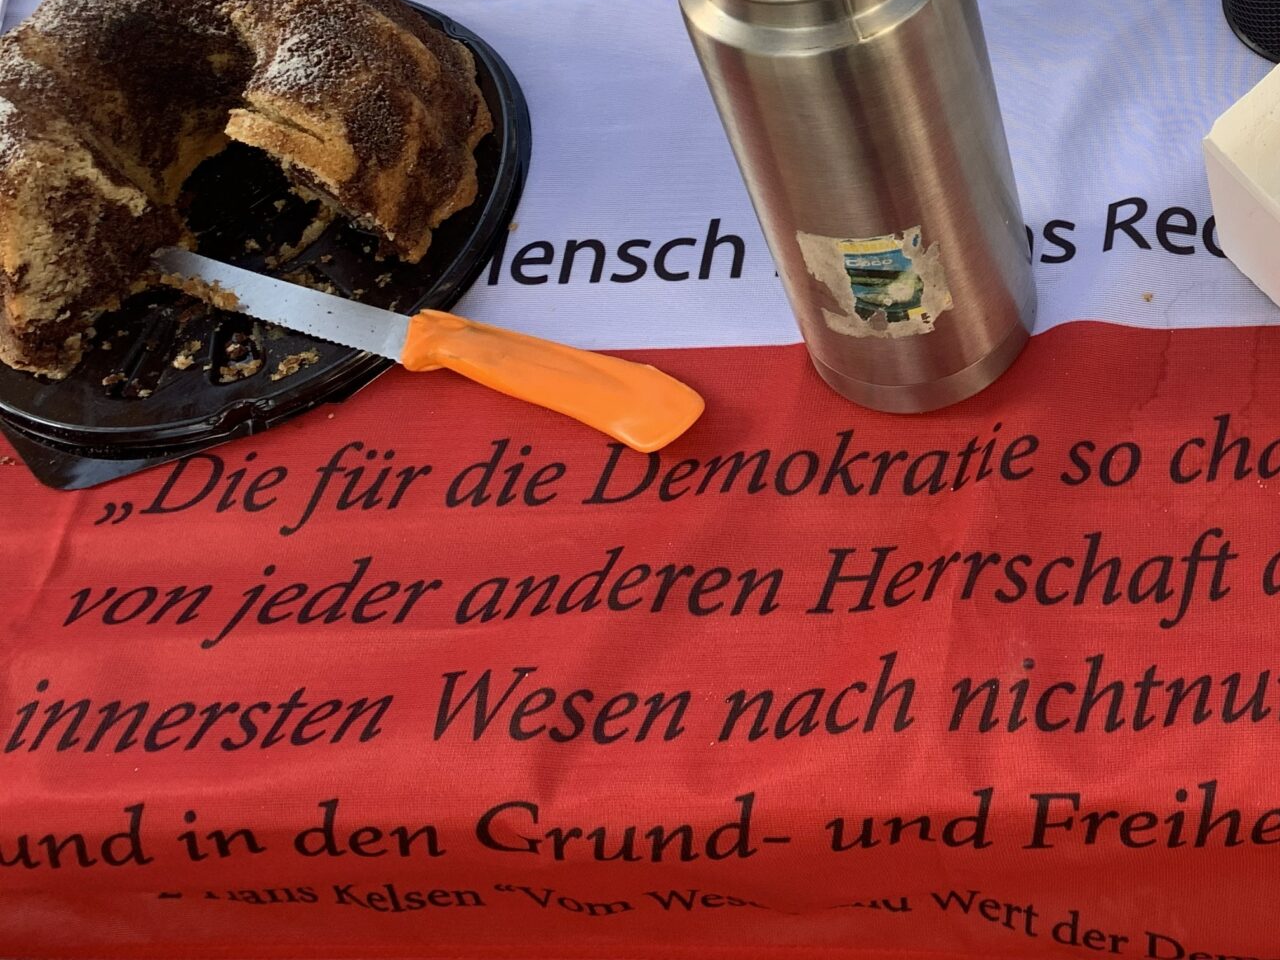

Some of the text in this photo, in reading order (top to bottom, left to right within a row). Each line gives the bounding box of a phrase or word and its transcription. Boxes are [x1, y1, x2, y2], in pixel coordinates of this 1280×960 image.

[1102, 196, 1228, 259] Rec
[279, 441, 432, 537] für
[445, 438, 567, 508] die
[582, 422, 1040, 506] Demokratie
[1059, 440, 1142, 487] so
[63, 584, 214, 628] von
[201, 556, 442, 649] jeder
[455, 546, 784, 625] anderen
[807, 527, 1238, 629] Herrschaft
[5, 679, 393, 753] innersten
[434, 666, 691, 745] Wesen
[712, 652, 916, 744] nach
[178, 810, 267, 862] in
[294, 798, 445, 858] den
[475, 793, 791, 863] Grund-
[826, 787, 992, 852] und
[333, 883, 484, 913] Kelsen
[931, 889, 1040, 937] Wert
[1051, 910, 1129, 954] der
